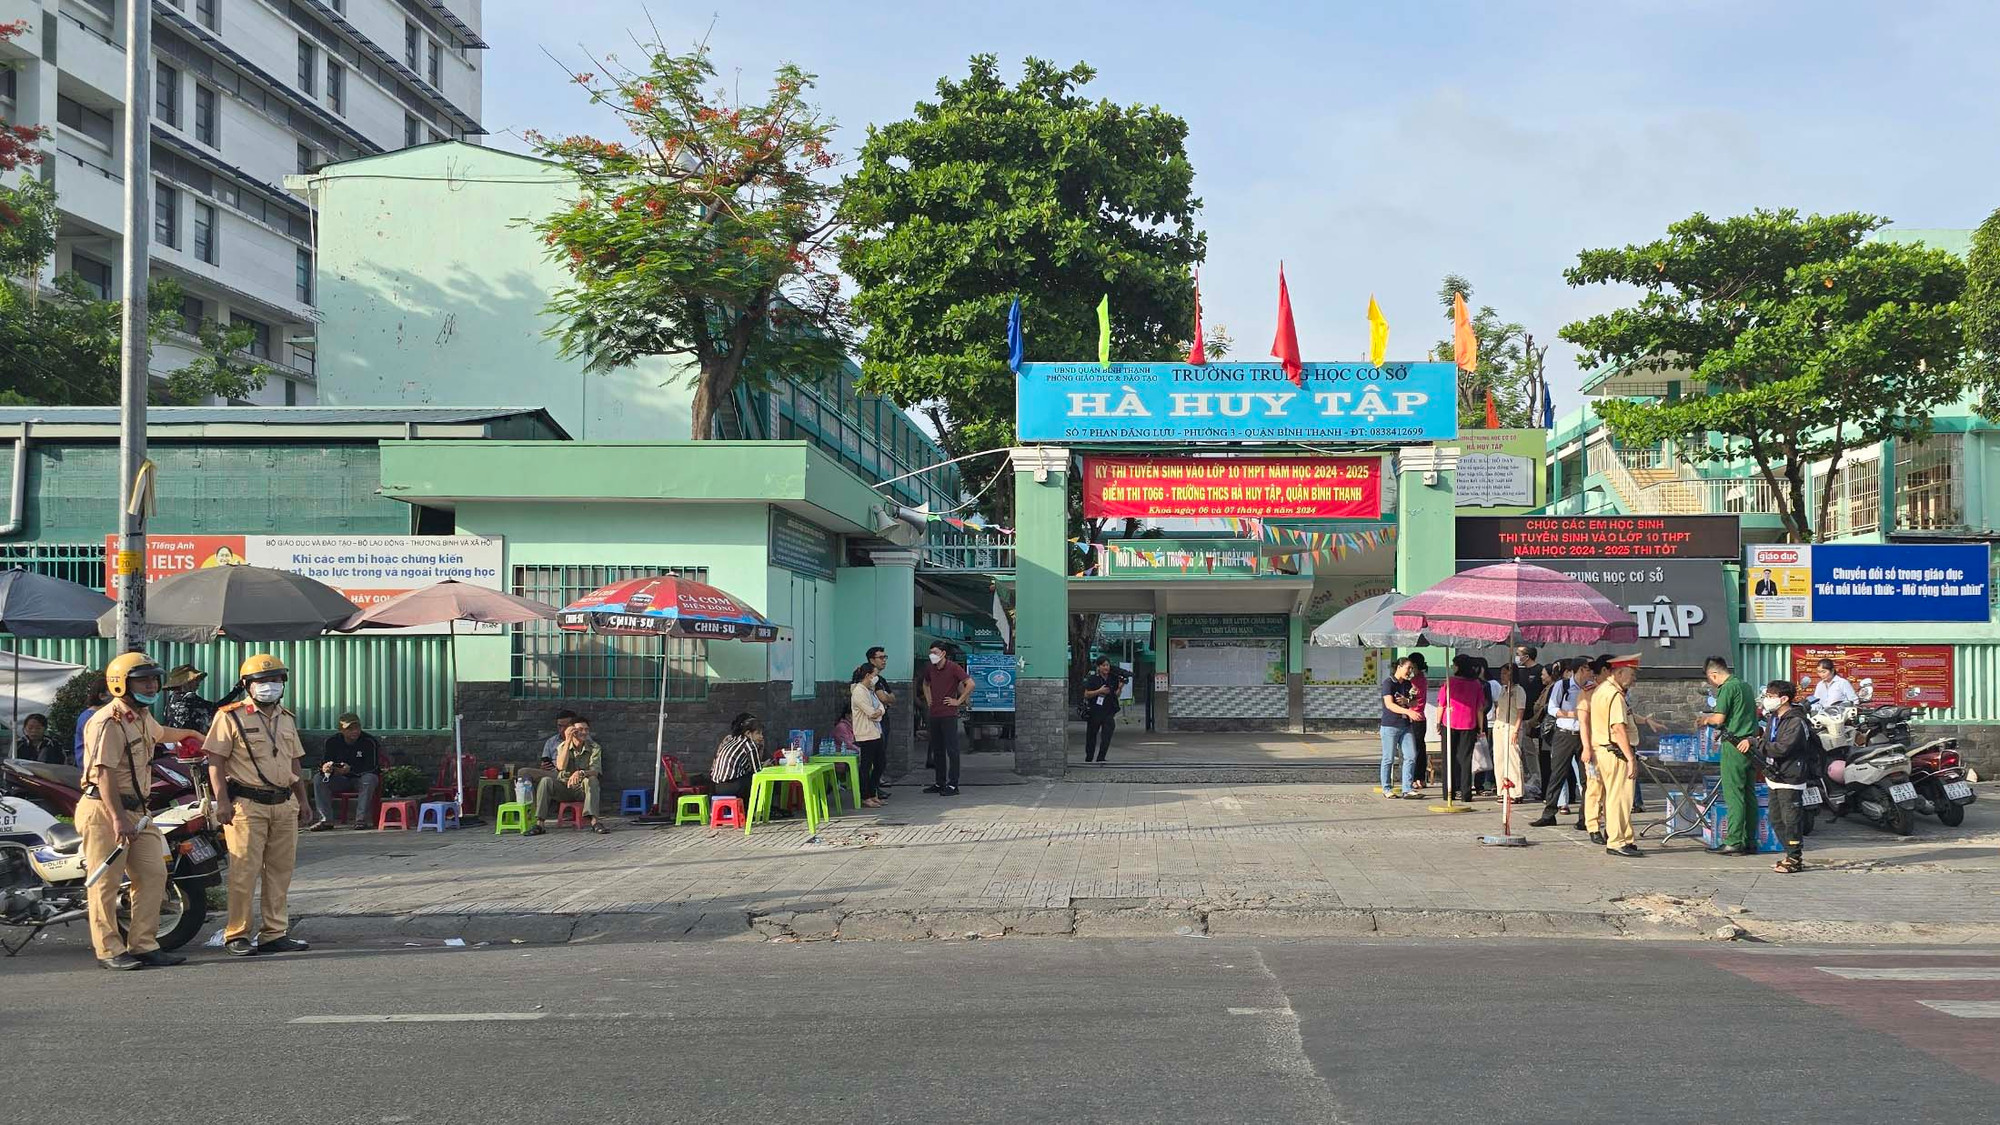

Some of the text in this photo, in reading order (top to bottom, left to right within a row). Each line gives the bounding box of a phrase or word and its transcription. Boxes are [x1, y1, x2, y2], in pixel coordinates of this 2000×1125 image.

[1172, 365, 1408, 383] TRƯỜNG TRUG HỌC CƠ SỞ
[1067, 384, 1429, 422] HÀ HUY TẬP
[1065, 427, 1423, 438] SỐ 7 PHAN ĐĂNG LƯU PHƯỜNG 3 QUẬN BÌNH THẠNH ĐT: 0838412699
[1095, 460, 1369, 481] KỲ THI TUYỂN SINH VÀO LỚP 10 THPT NĂM HỌC 2024 2025
[1102, 480, 1124, 501] ĐIỂM
[1126, 487, 1140, 501] THI
[1171, 484, 1205, 501] TRƯỜNG
[1207, 487, 1229, 501] THCS
[1231, 484, 1242, 500] HÀ
[1245, 487, 1262, 500] HUY
[1265, 484, 1284, 503] TẬP,
[1286, 484, 1309, 503] QUẬN
[1311, 484, 1331, 501] BÌNH
[1333, 487, 1362, 504] THẠNH
[1175, 507, 1196, 516] ngày
[1237, 506, 1263, 516] tháng
[1526, 518, 1664, 531] CHÚC CÁC EM HỌC SINH
[1498, 531, 1691, 542] THI TUYỂN SINH VÀO LỚP 10 THPT
[151, 541, 175, 550] Tiếng
[177, 541, 195, 550] Anh
[1513, 543, 1678, 557] NĂM HỌC 2024 2025 THI TỐT
[152, 554, 195, 570] IELTS
[292, 554, 312, 564] Khi
[314, 554, 335, 564] các
[338, 556, 356, 564] em
[357, 554, 368, 565] bị
[401, 554, 436, 565] chứng
[439, 553, 463, 564] kiến
[1222, 548, 1241, 567] NGÀY
[309, 567, 330, 578] bạo
[332, 567, 349, 578] lực
[351, 568, 382, 578] trong
[435, 567, 472, 578] trường
[474, 567, 495, 578] học
[1603, 571, 1626, 585] HỌC
[1629, 570, 1645, 582] CƠ
[1649, 566, 1664, 582] SỞ
[1833, 565, 1867, 580] Chuyển
[1885, 566, 1896, 579] số
[1898, 569, 1922, 581] trong
[1924, 568, 1944, 581] giáo
[1946, 568, 1964, 582] dục
[1836, 582, 1850, 595] nối
[1852, 582, 1872, 595] kiến
[1874, 583, 1895, 595] thức
[1902, 582, 1917, 595] Mở
[1918, 583, 1939, 597] rộng
[1941, 582, 1959, 596] tầm
[610, 615, 655, 628] CHIN-SU
[1628, 595, 1705, 647] TẬP
